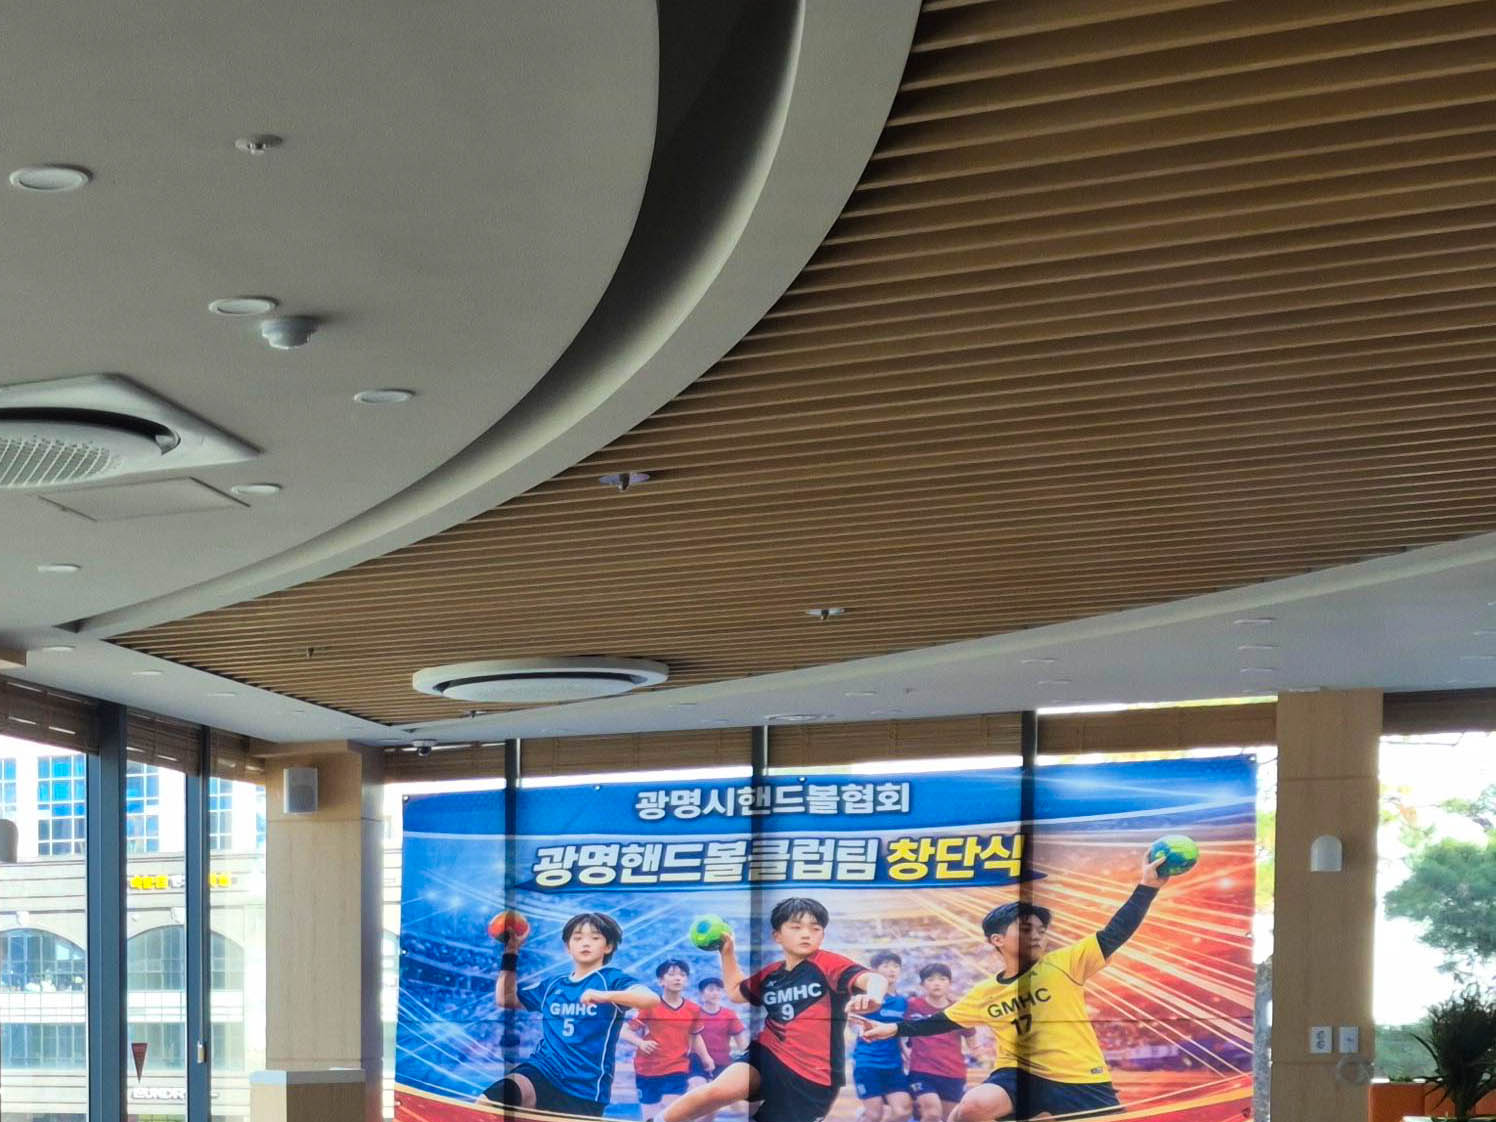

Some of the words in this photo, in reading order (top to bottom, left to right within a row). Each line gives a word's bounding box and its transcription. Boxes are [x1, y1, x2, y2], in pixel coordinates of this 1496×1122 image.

[635, 782, 910, 821] 광명시핸드볼협회
[532, 838, 880, 888] 광명핸드볼클럽팀
[885, 834, 1025, 881] 창단식
[763, 982, 822, 1005] GMHC
[987, 988, 1051, 1018] GMHC
[550, 1003, 598, 1016] GMHC
[782, 1004, 795, 1021] 9
[562, 1018, 575, 1037] 5
[1011, 1013, 1033, 1036] 17
